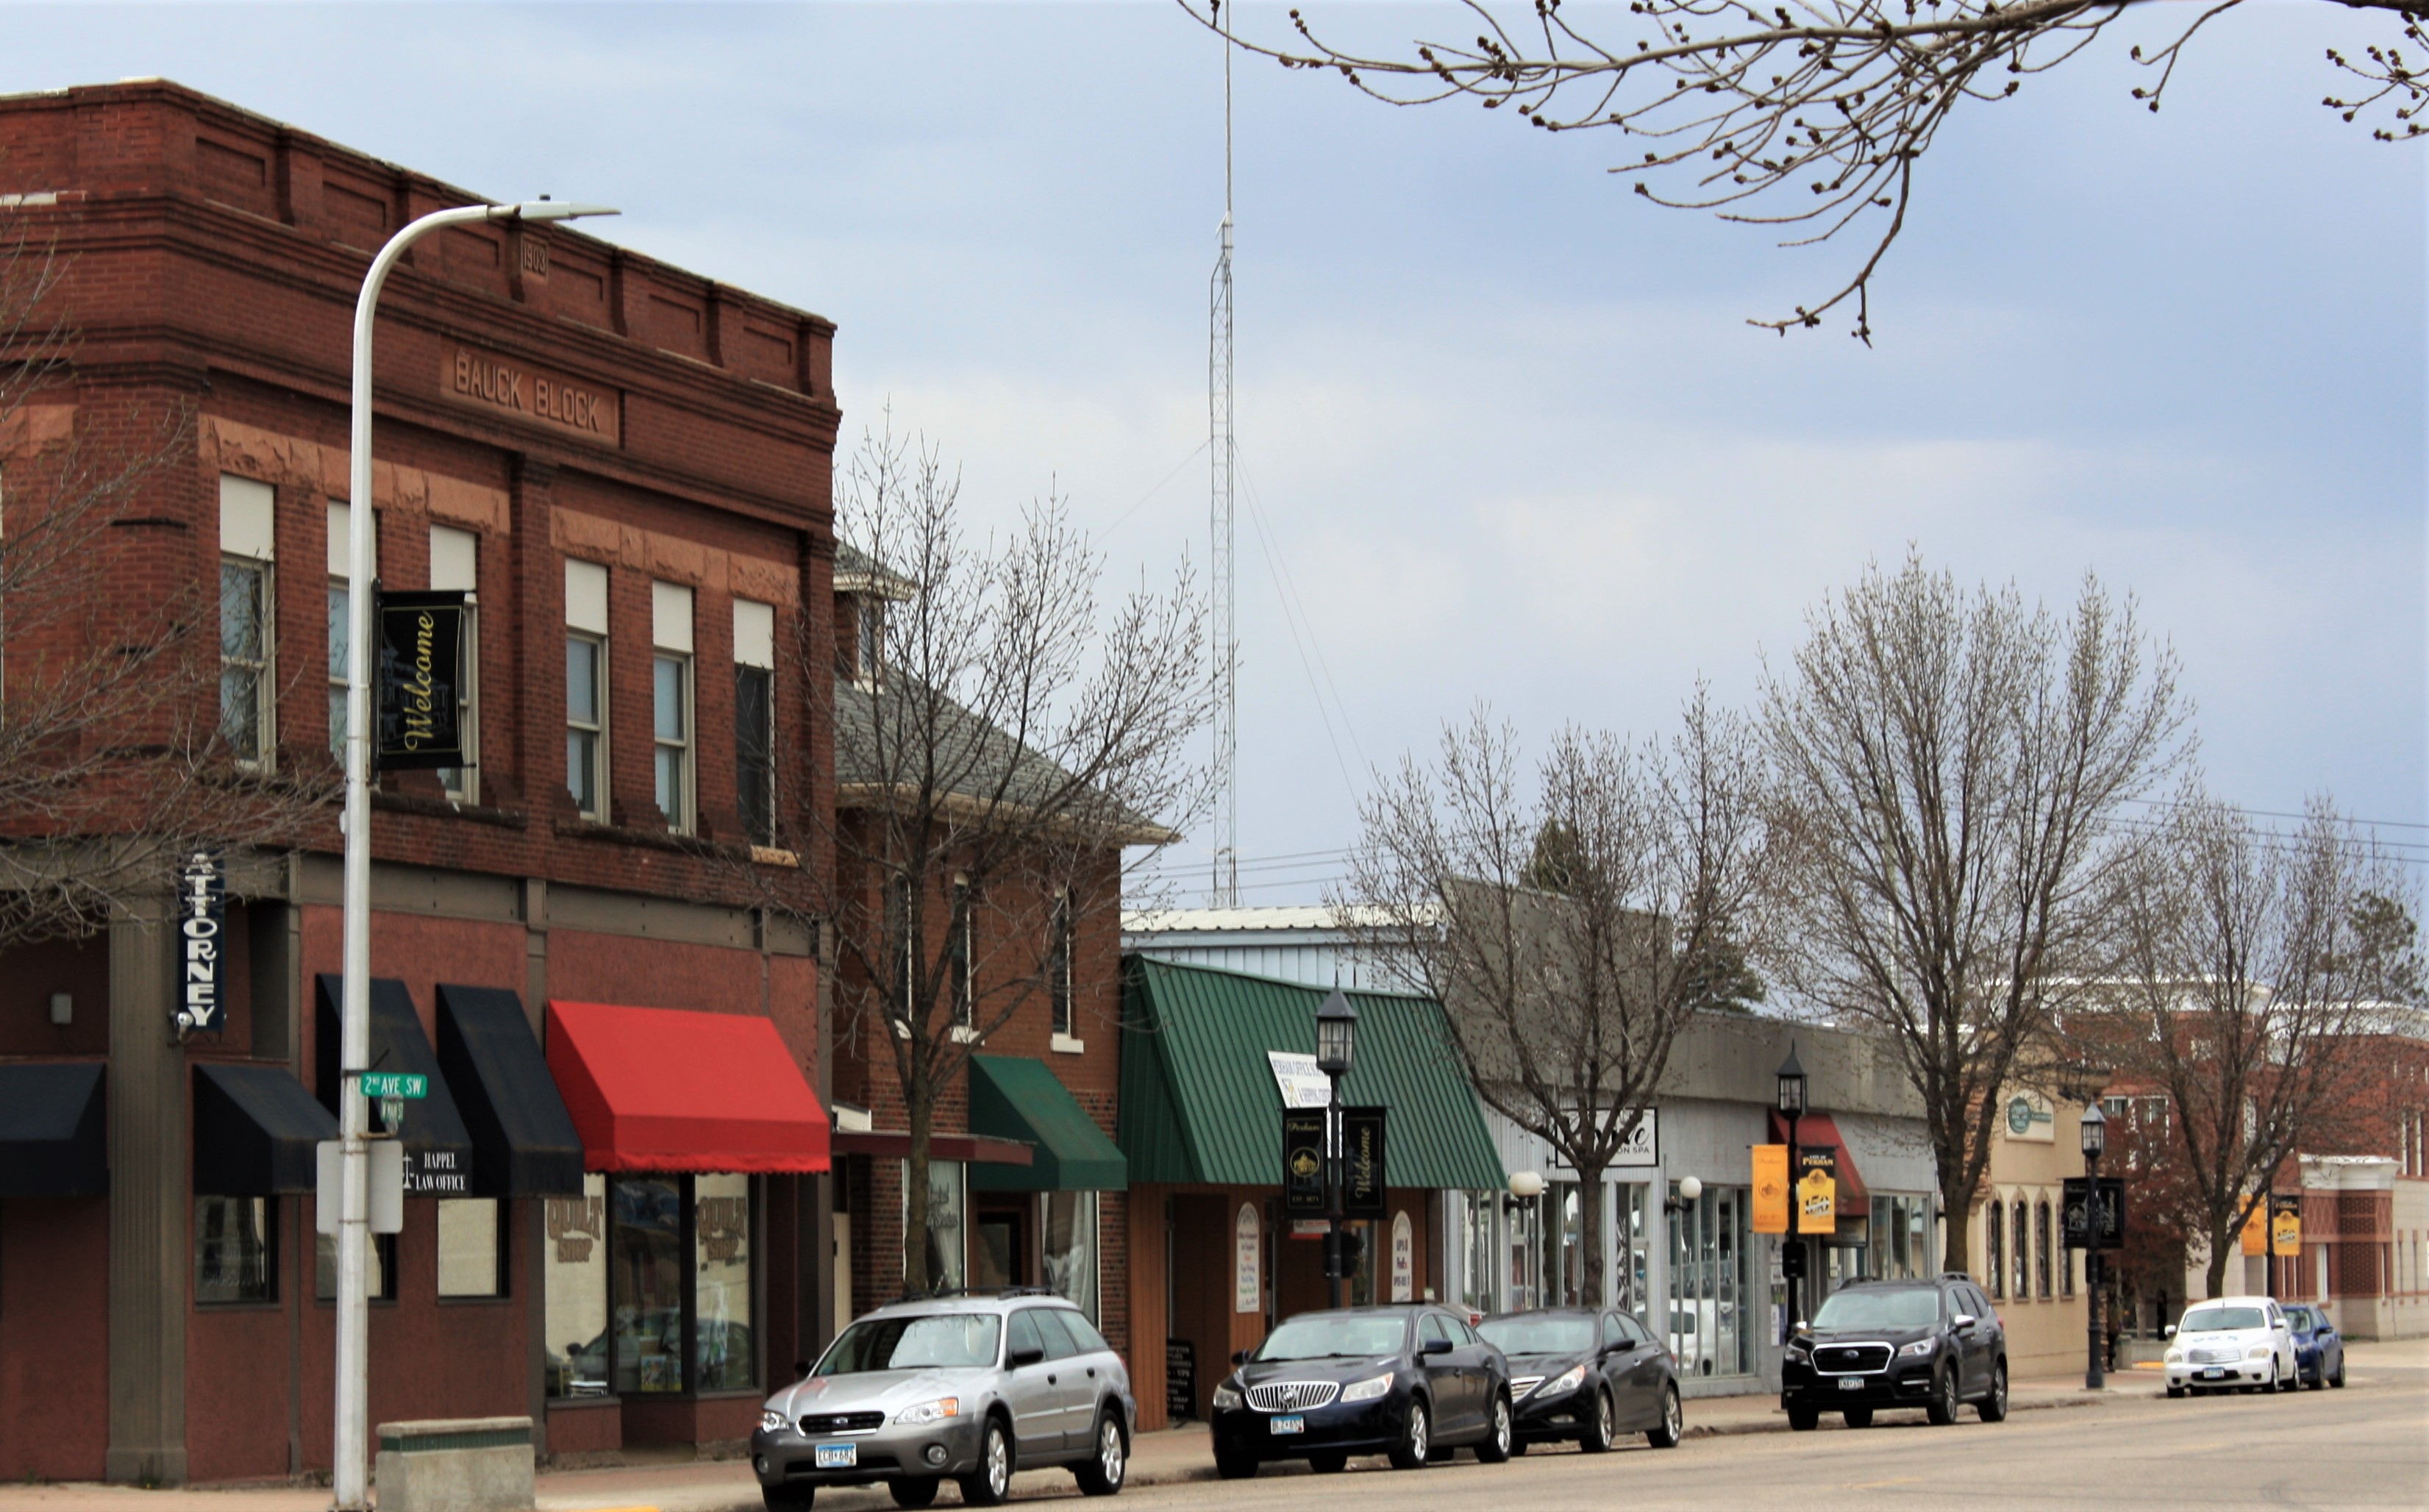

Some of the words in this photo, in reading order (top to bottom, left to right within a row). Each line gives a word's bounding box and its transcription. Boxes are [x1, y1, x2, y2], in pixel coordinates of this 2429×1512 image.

[454, 351, 521, 410] BAUCK
[535, 377, 599, 433] BLOCK
[402, 609, 434, 751] Welcome
[183, 853, 218, 1027] ATTORNEY
[381, 1076, 401, 1094] AVE
[406, 1077, 422, 1095] SW
[424, 1152, 457, 1169] HAPPEL
[1354, 1125, 1372, 1199] Welcome
[1802, 1157, 1834, 1166] PERHAM
[415, 1174, 435, 1191] LAW
[435, 1174, 466, 1191] OFFICE
[547, 1196, 603, 1241] QUILT
[698, 1197, 747, 1240] QUILT
[557, 1238, 593, 1263] SHOP
[707, 1237, 739, 1260] SHOP
